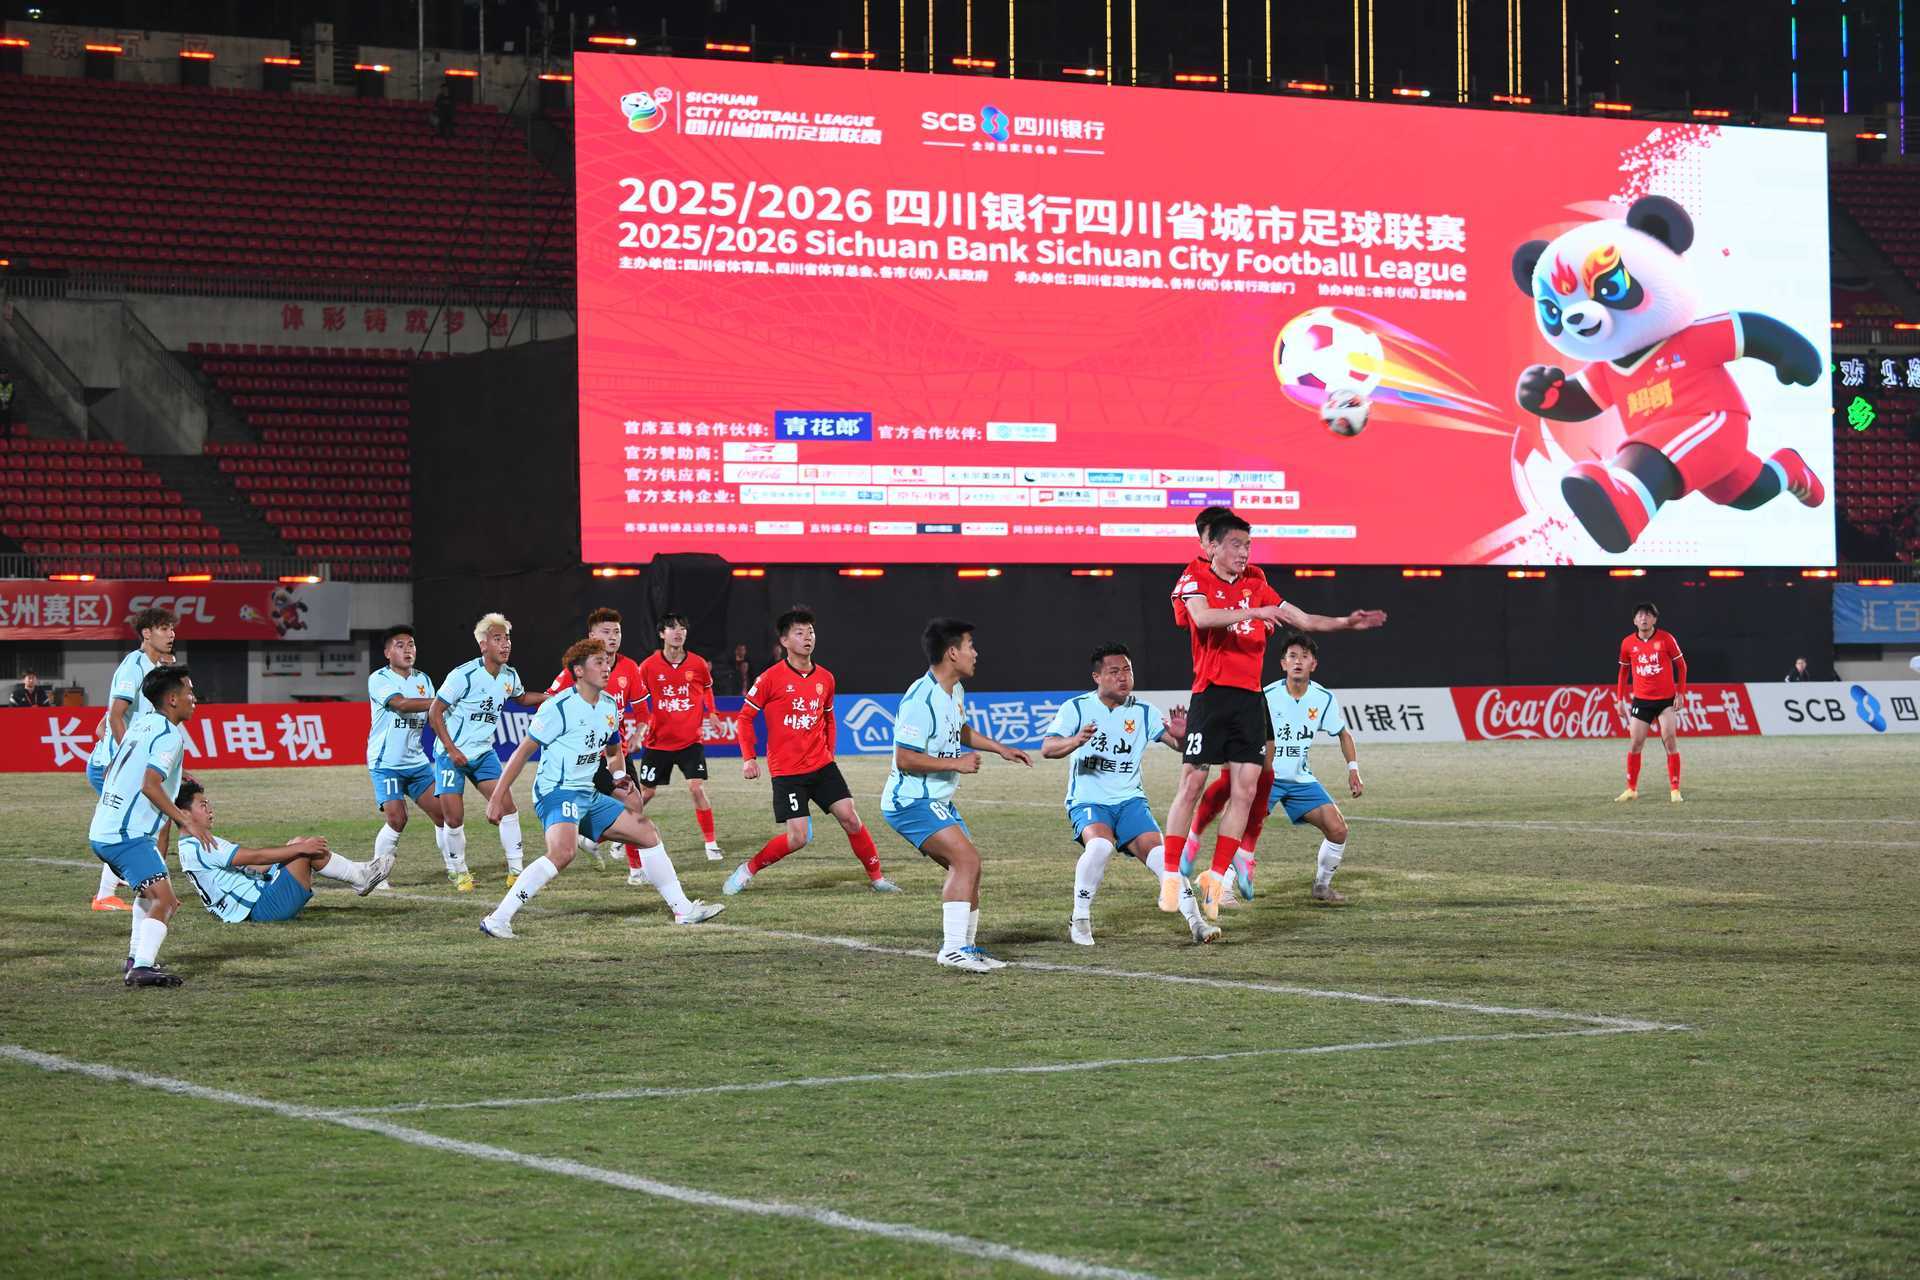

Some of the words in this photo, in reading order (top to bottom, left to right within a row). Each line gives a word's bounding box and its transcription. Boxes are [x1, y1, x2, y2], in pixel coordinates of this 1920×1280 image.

[685, 91, 759, 106] SICHUAN
[685, 106, 721, 119] CITY
[728, 109, 811, 124] FOOTBALL
[814, 113, 876, 127] LEAGUE
[921, 111, 976, 132] SCB
[1014, 116, 1105, 140] 四川银行
[618, 177, 873, 224] 2025/2026
[886, 187, 1467, 253] 四川银行四川省城市足球联赛
[618, 222, 798, 255] 2025/2026
[805, 229, 938, 260] Sichuan
[947, 236, 1029, 264] Bank
[1035, 239, 1161, 269] Sichuan
[1168, 244, 1231, 278] City
[1236, 247, 1357, 279] Football
[1365, 253, 1467, 287] League
[783, 416, 862, 437] 青花郎
[877, 425, 982, 441] 官方合作伙伴：
[624, 445, 719, 461] 官方赞助商：
[624, 467, 719, 482] 官方供应商：
[625, 489, 736, 504] 官方支持企业：
[663, 683, 690, 697] 达州
[792, 697, 820, 711] 达州
[1475, 687, 1612, 740] Coca-Cola
[1784, 698, 1846, 722] SCB
[965, 701, 1062, 744] 动爱家
[1342, 703, 1424, 732] 川银行
[41, 713, 332, 768] 长AI电视
[1277, 723, 1314, 741] 凉山
[1090, 732, 1132, 754] 凉山
[1186, 733, 1202, 755] 23
[640, 765, 656, 781] 36
[1084, 756, 1134, 774] 好医生
[788, 793, 799, 811] 5
